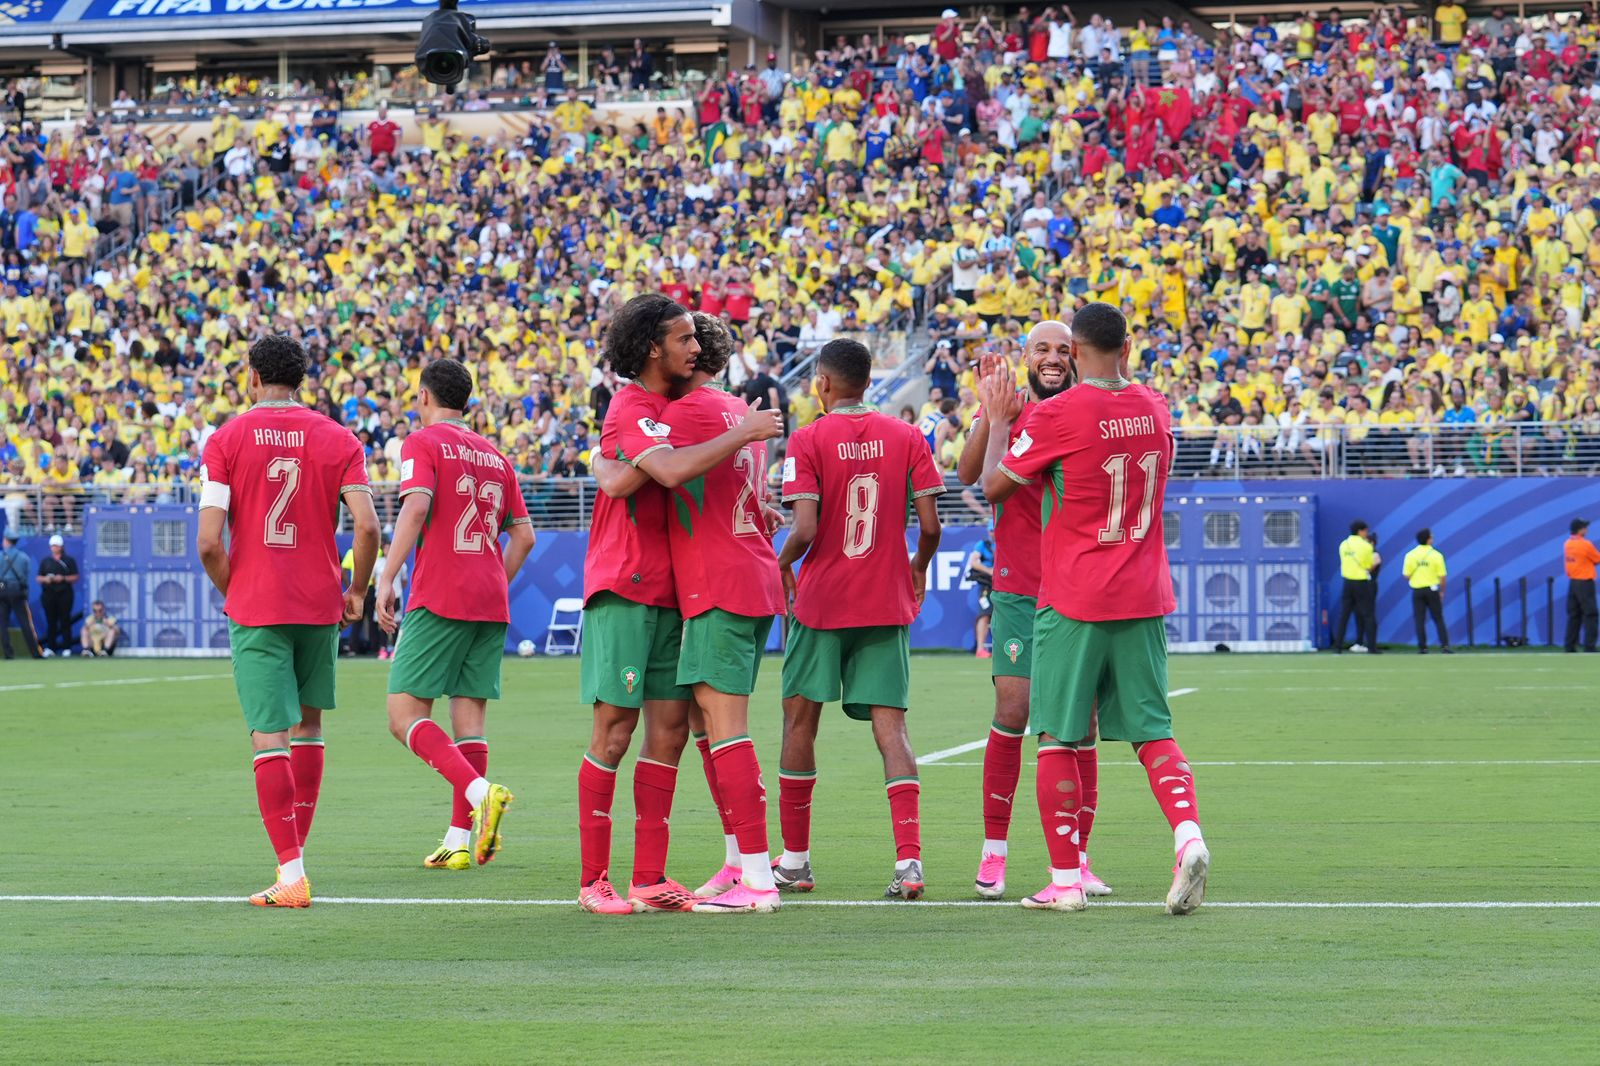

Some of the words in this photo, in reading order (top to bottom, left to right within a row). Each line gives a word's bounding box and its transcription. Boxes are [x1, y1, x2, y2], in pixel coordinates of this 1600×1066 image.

[108, 0, 212, 16] FIFA
[253, 428, 304, 448] HAKIMI
[440, 443, 457, 459] EL
[1099, 415, 1155, 440] SAIBARI
[263, 456, 301, 548] 2
[453, 473, 504, 555] 23
[842, 472, 880, 560] 8
[1098, 450, 1162, 545] 11
